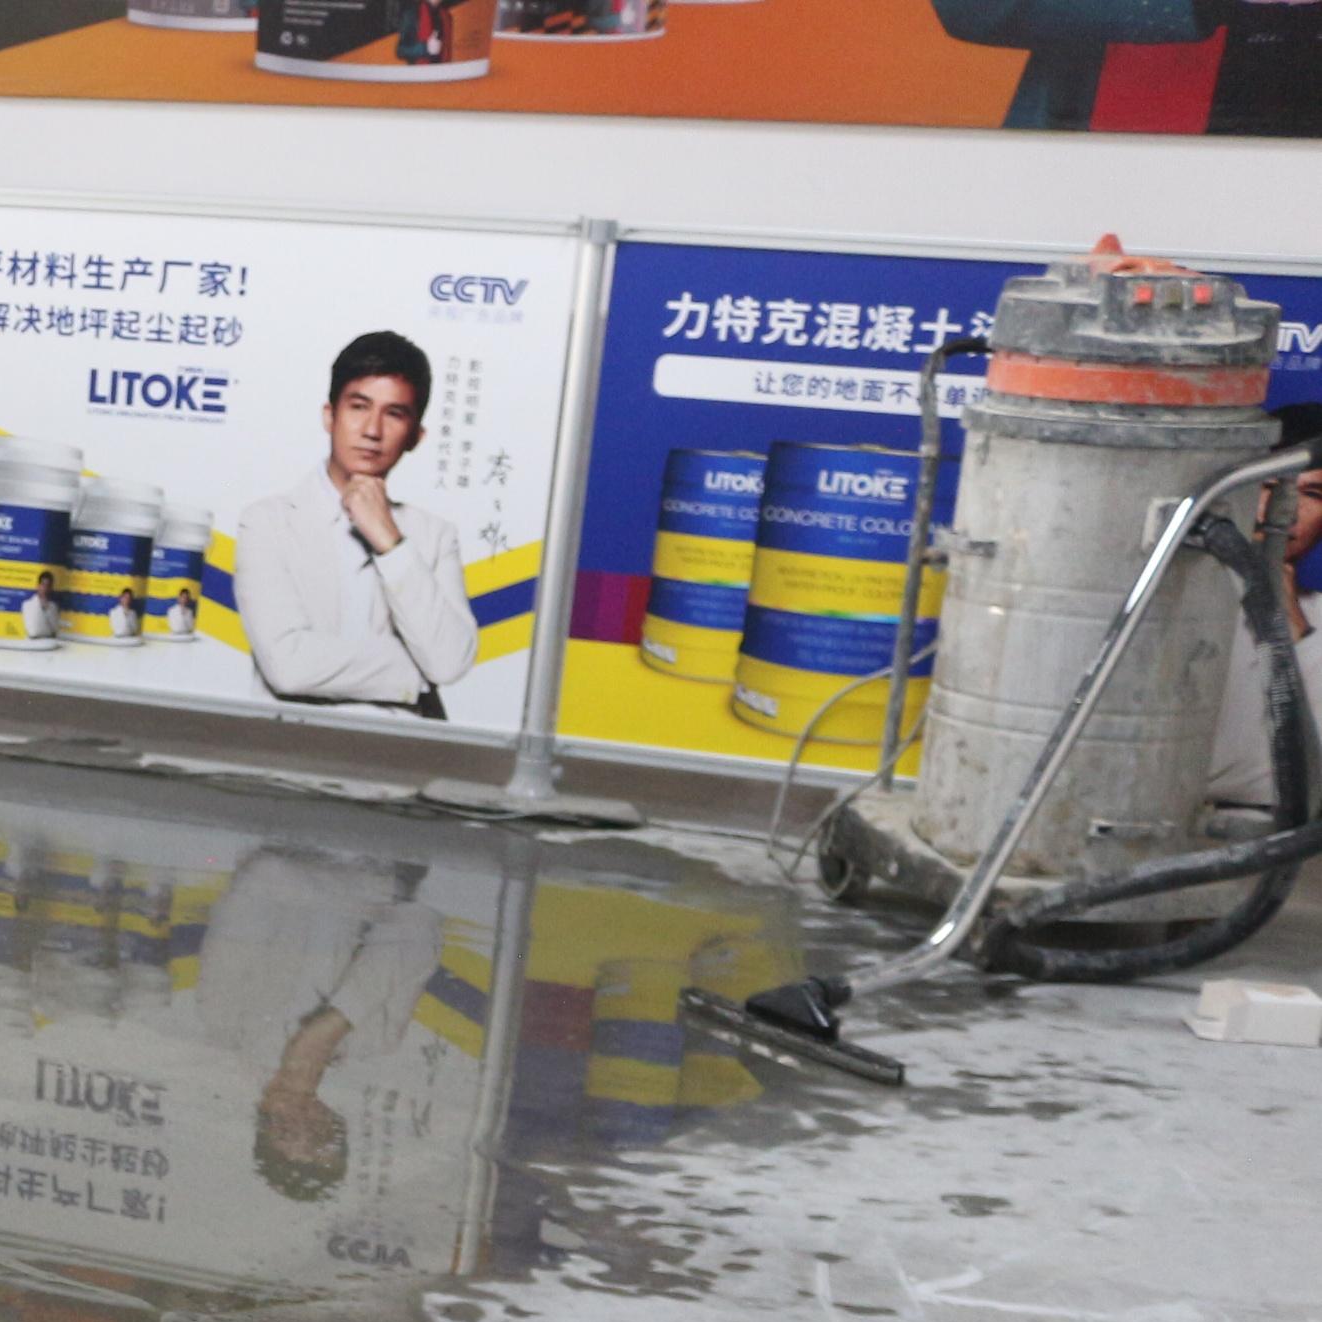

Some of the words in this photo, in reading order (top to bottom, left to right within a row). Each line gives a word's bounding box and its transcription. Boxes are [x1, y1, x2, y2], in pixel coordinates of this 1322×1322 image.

[430, 274, 529, 306] CCTV
[1277, 321, 1322, 354] TV
[89, 368, 229, 413] LITOKE
[754, 370, 991, 408] 让您的地面不单
[703, 470, 765, 494] LITOK
[817, 469, 910, 501] LITOKE
[763, 504, 857, 533] CONCRETE
